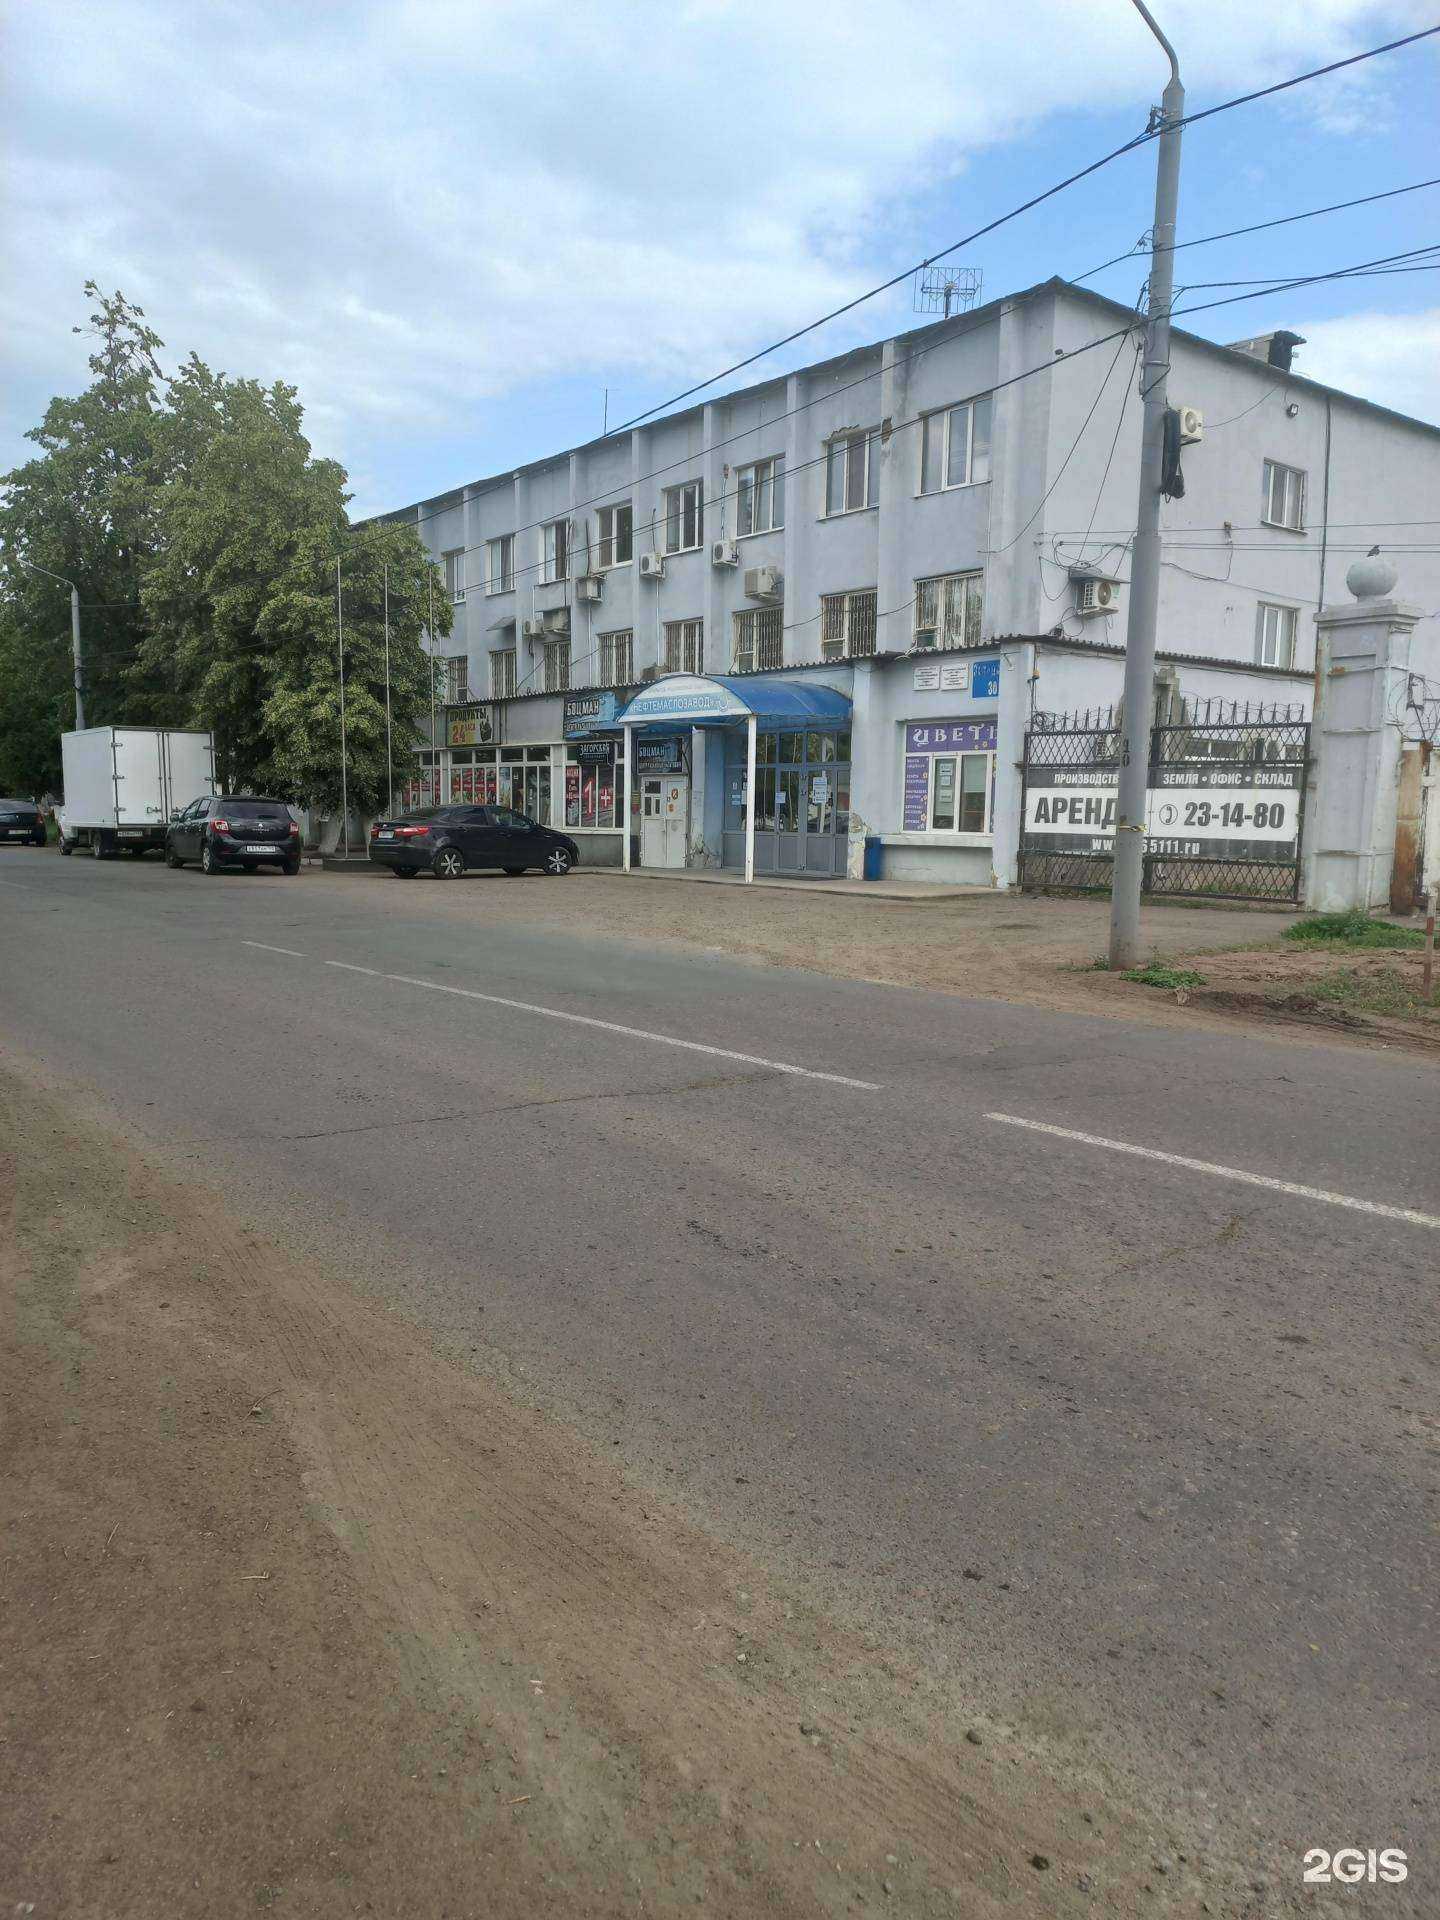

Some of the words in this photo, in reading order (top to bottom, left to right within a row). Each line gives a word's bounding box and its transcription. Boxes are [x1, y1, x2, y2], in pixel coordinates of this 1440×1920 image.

[1054, 773, 1119, 786] ПРОИЗВОДСТВ
[1163, 773, 1198, 785] ЗЕМЛЯ
[1210, 773, 1242, 786] ОФИС
[1254, 773, 1293, 787] СКЛАД
[1034, 797, 1119, 830] АРЕНД
[1183, 801, 1285, 829] 23-14-80
